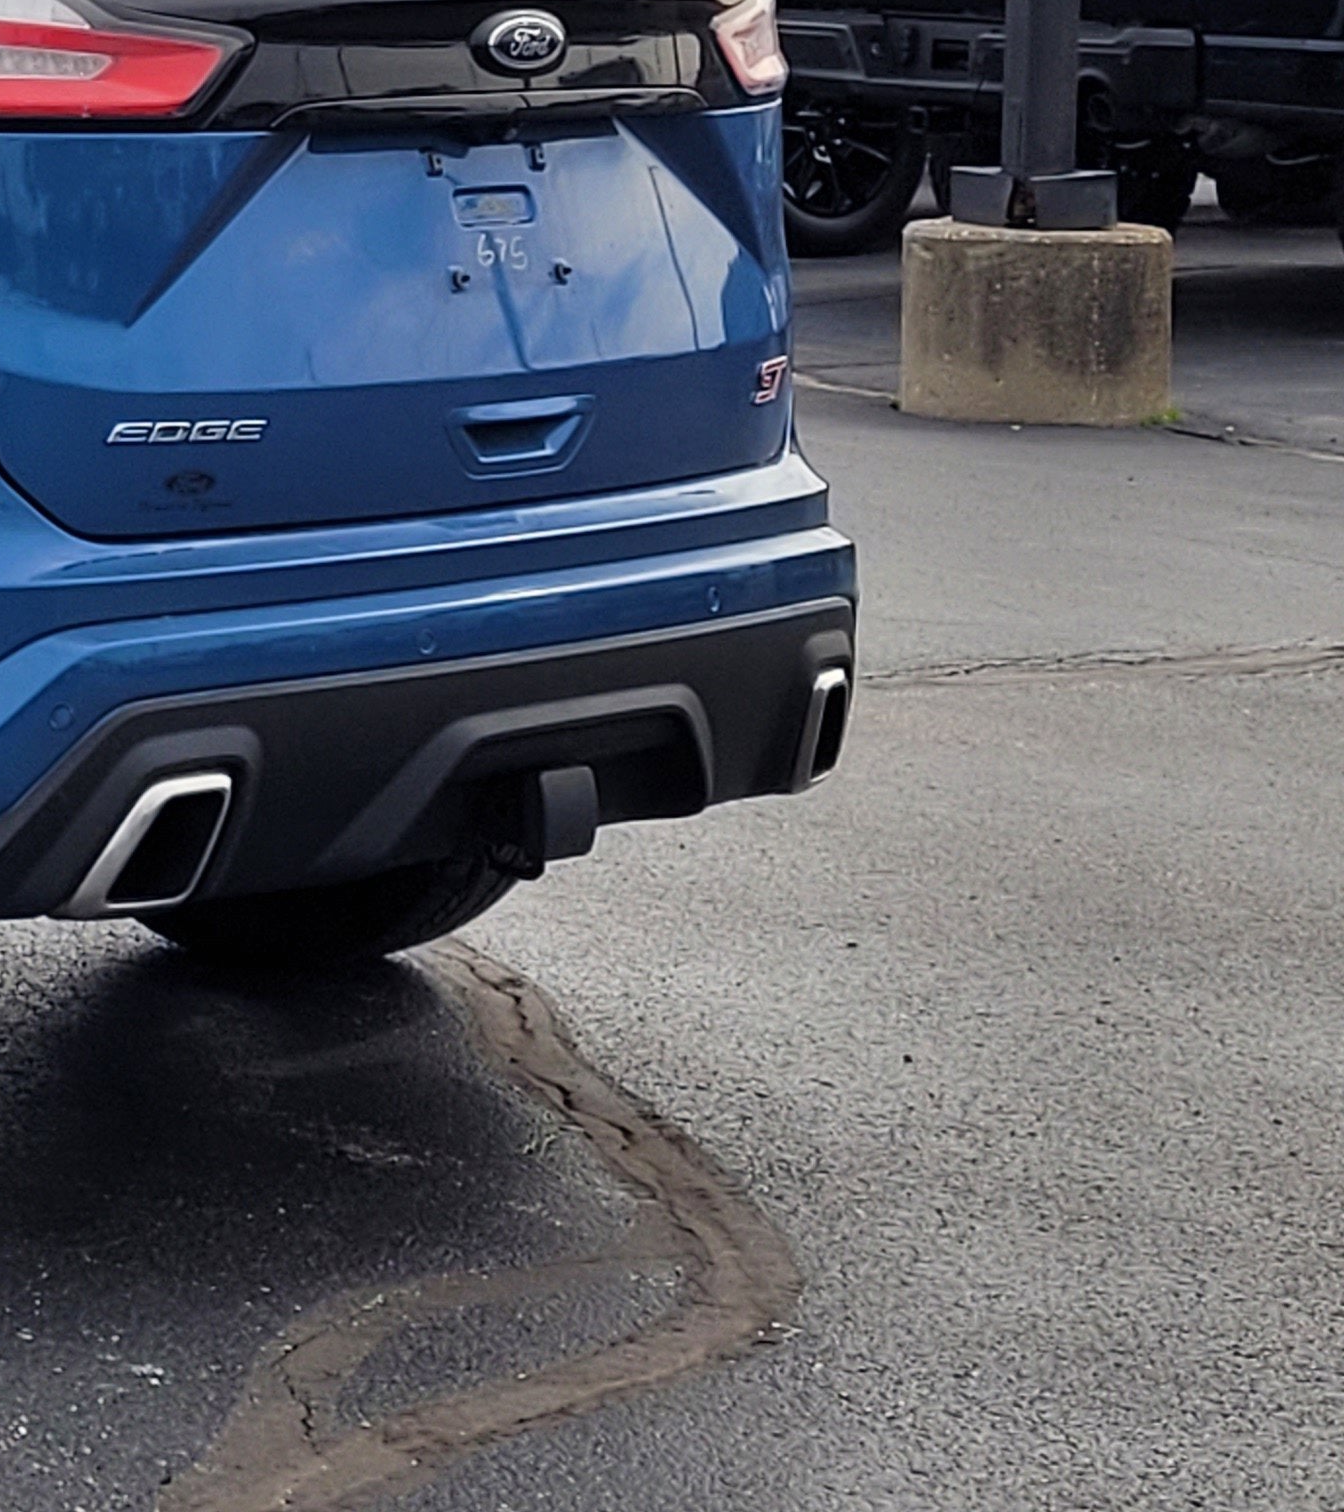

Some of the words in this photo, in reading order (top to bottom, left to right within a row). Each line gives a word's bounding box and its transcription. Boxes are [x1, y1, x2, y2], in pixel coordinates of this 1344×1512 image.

[510, 28, 552, 57] Ford
[477, 233, 529, 270] 675
[754, 355, 788, 404] ST
[106, 419, 268, 444] EDGE
